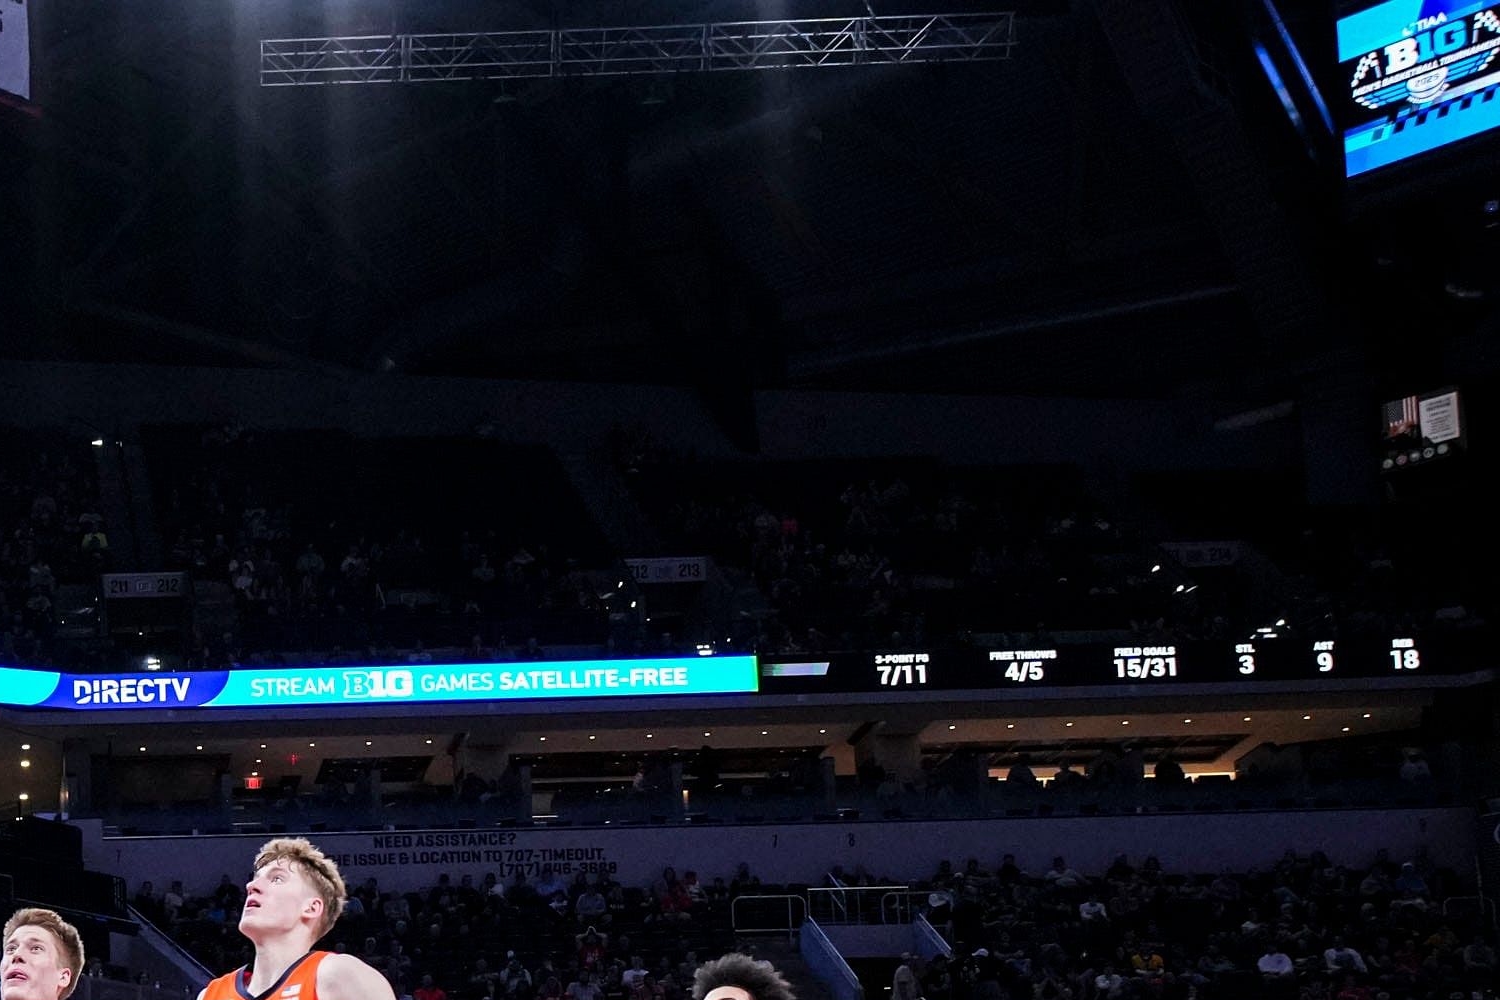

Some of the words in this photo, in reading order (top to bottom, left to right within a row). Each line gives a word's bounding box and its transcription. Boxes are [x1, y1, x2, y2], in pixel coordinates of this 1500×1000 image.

[1384, 20, 1467, 75] B1G
[108, 578, 130, 594] 211
[156, 577, 180, 593] 212
[1113, 657, 1177, 679] 15/31
[1239, 655, 1255, 675] 3
[1317, 653, 1333, 672] 9
[1390, 650, 1420, 669] 18
[877, 665, 927, 686] 7/11
[1004, 662, 1044, 682] 4/5
[73, 677, 192, 704] DIRECTV
[250, 677, 335, 698] STREAM
[420, 672, 493, 693] GAMES
[499, 667, 688, 690] SATELLITE-FREE
[374, 836, 411, 848] NEED
[416, 832, 517, 848] ASSISTANCE?
[354, 854, 396, 866] ISSUE
[412, 851, 482, 865] LOCATION
[486, 851, 501, 863] TO
